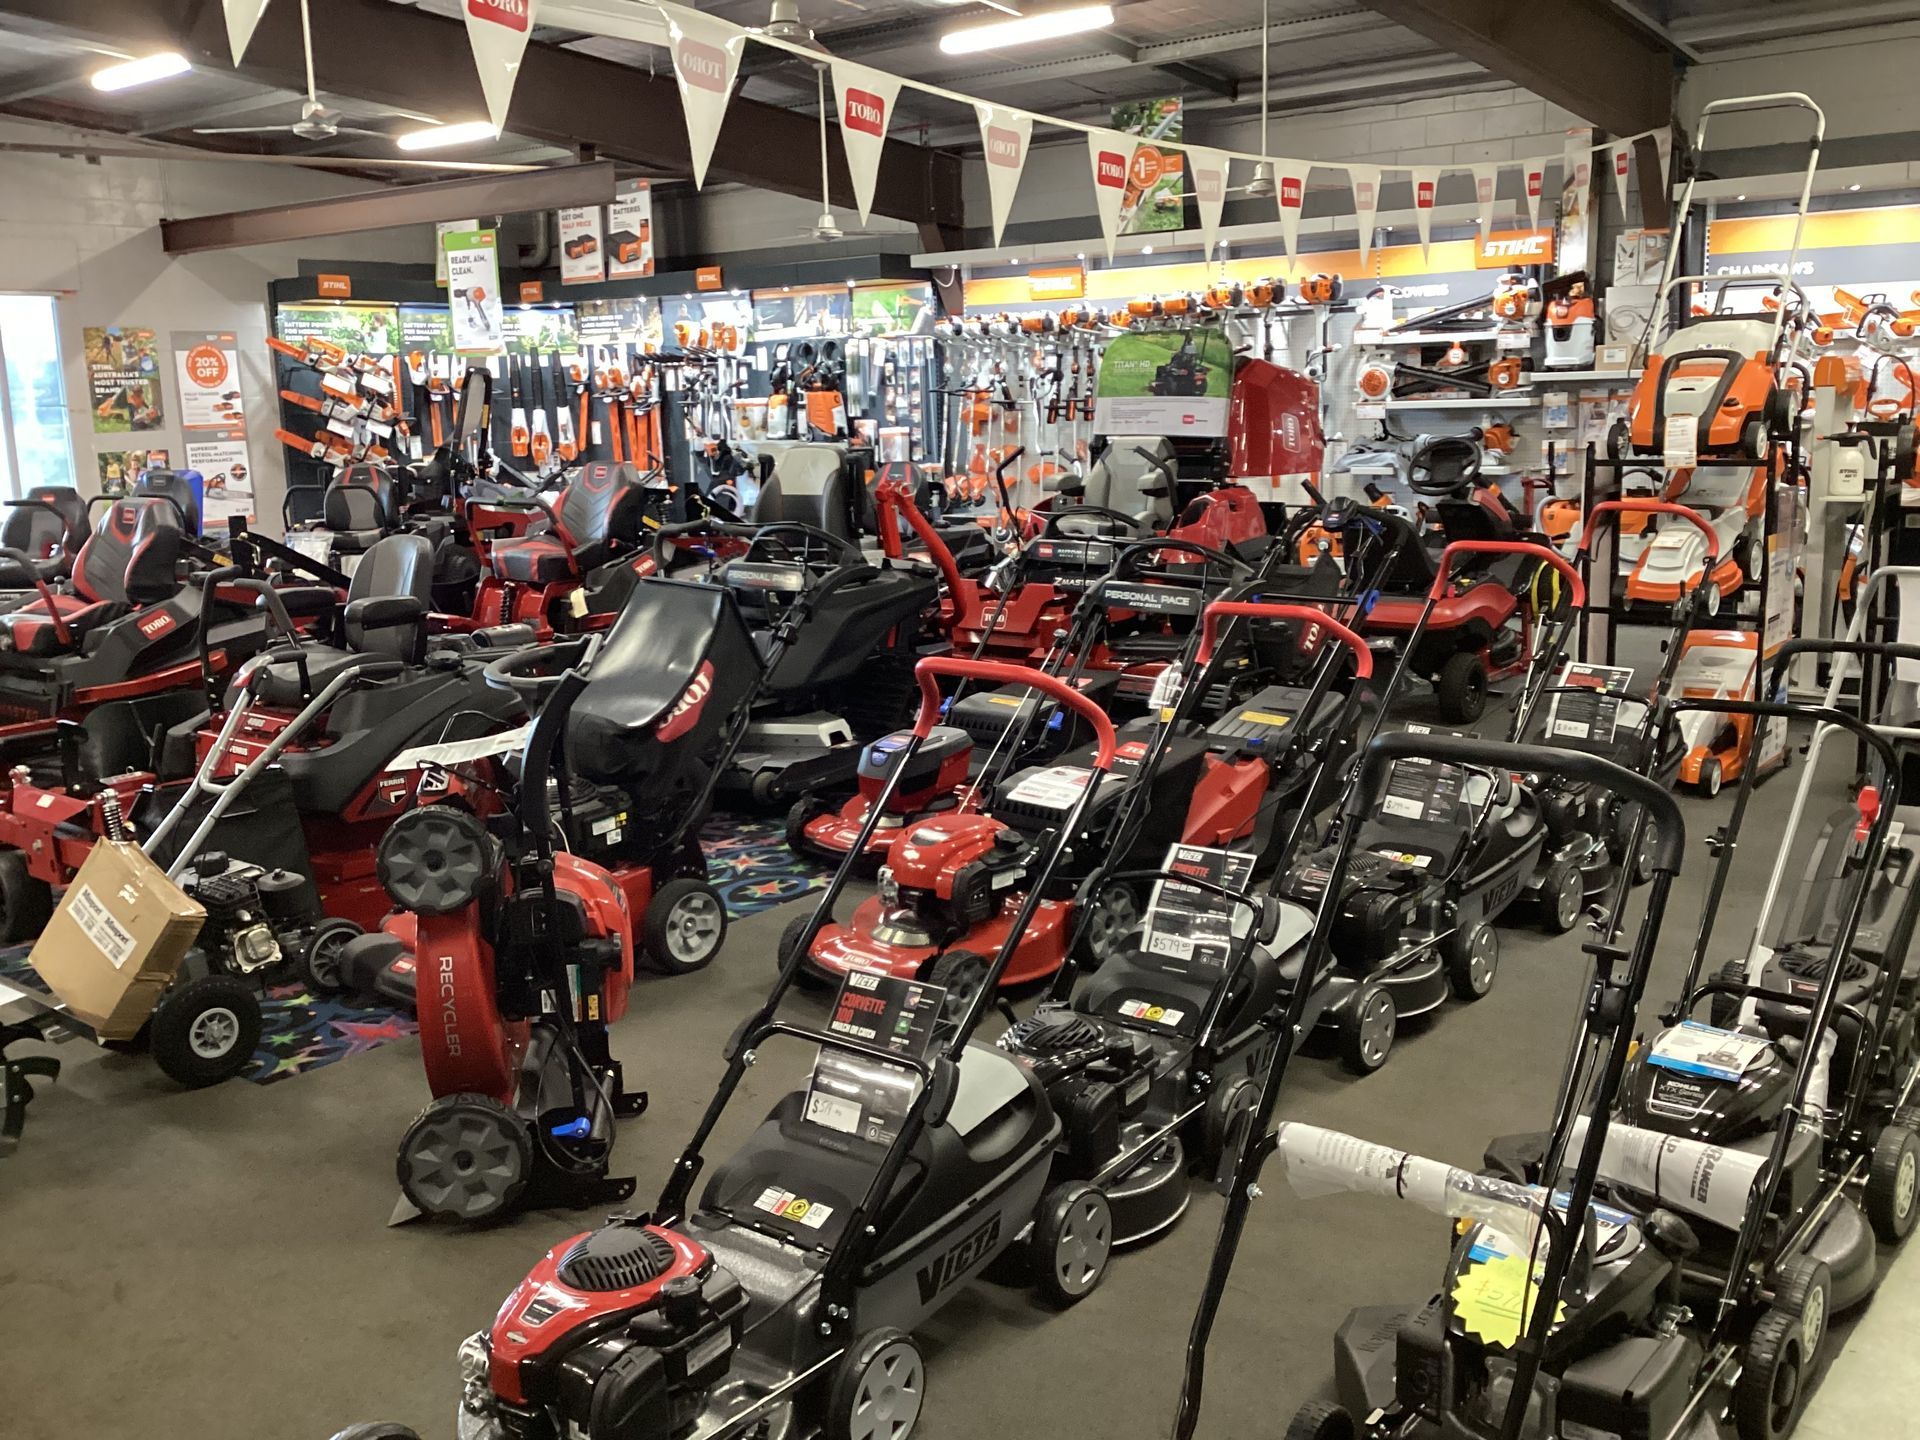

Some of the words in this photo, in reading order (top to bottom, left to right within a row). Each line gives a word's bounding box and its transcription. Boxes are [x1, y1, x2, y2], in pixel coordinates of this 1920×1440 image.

[848, 100, 881, 125] TORO
[1100, 162, 1124, 179] TORO
[613, 205, 641, 215] BATTERIES
[1481, 236, 1545, 258] STIHL
[322, 281, 348, 289] STIHL
[698, 274, 718, 282] STIHL
[195, 357, 219, 367] 20%
[1140, 360, 1151, 368] HD
[93, 371, 139, 379] AUSTRALIA'S
[197, 367, 219, 378] OFF
[1286, 416, 1296, 448] TORO
[1105, 590, 1158, 603] PERSONAL
[1161, 595, 1190, 606] PACE
[143, 614, 171, 635] TORO
[380, 777, 405, 788] FERRIS
[848, 971, 881, 992] VICTA
[438, 955, 463, 1058] RECYCLER
[840, 991, 887, 1015] CORVETTE
[1666, 1080, 1702, 1092] KOHLER
[915, 1209, 1002, 1307] VICTA
